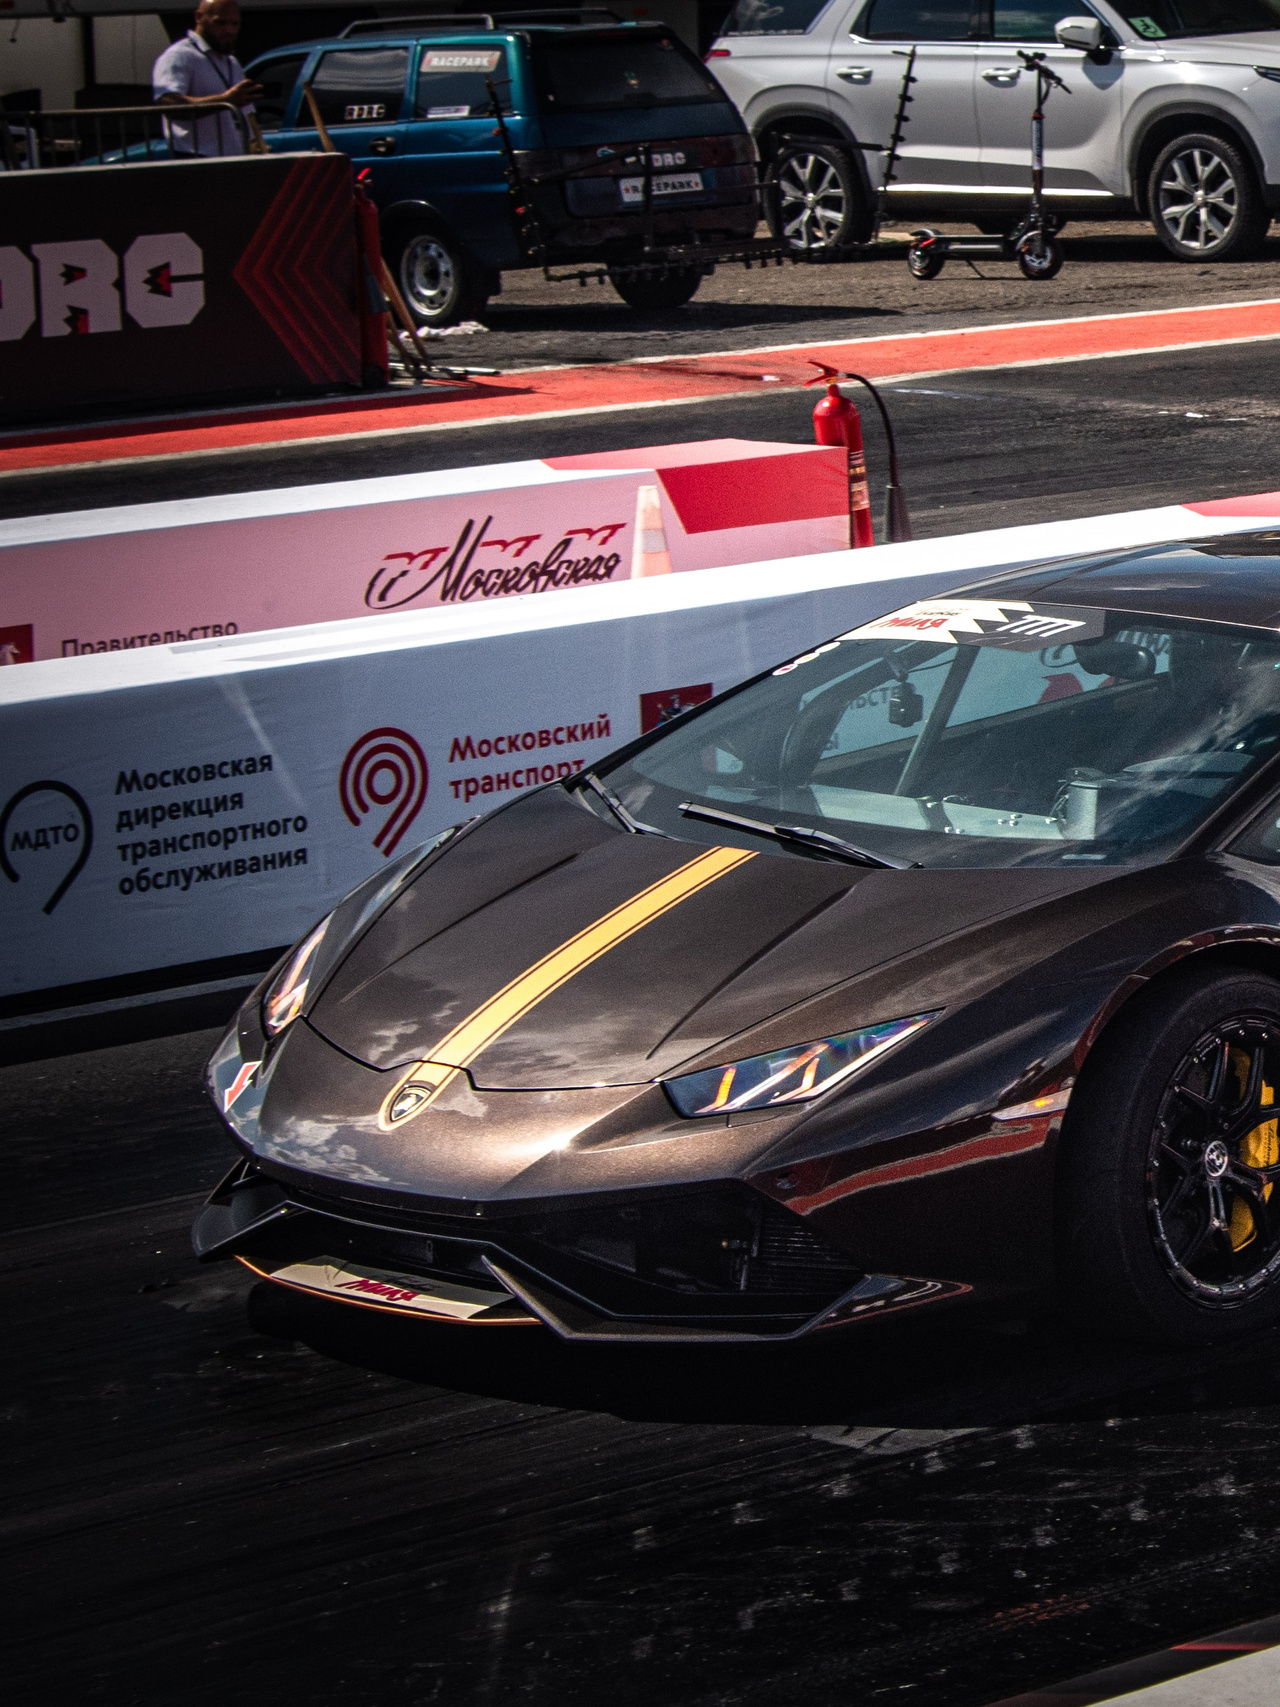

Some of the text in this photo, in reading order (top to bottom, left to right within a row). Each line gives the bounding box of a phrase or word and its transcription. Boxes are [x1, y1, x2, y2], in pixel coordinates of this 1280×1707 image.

[430, 56, 490, 67] RACEPARK
[640, 152, 686, 168] DRC
[631, 180, 694, 194] REPARK
[365, 515, 622, 610] Московская
[61, 621, 239, 659] Правительство
[448, 713, 612, 763] Московский
[115, 754, 273, 796] Московская
[449, 759, 585, 803] транспорт
[115, 792, 245, 833] дирекция
[11, 822, 80, 852] МДТО
[117, 815, 309, 866] транспортного
[118, 848, 309, 896] обслуживания
